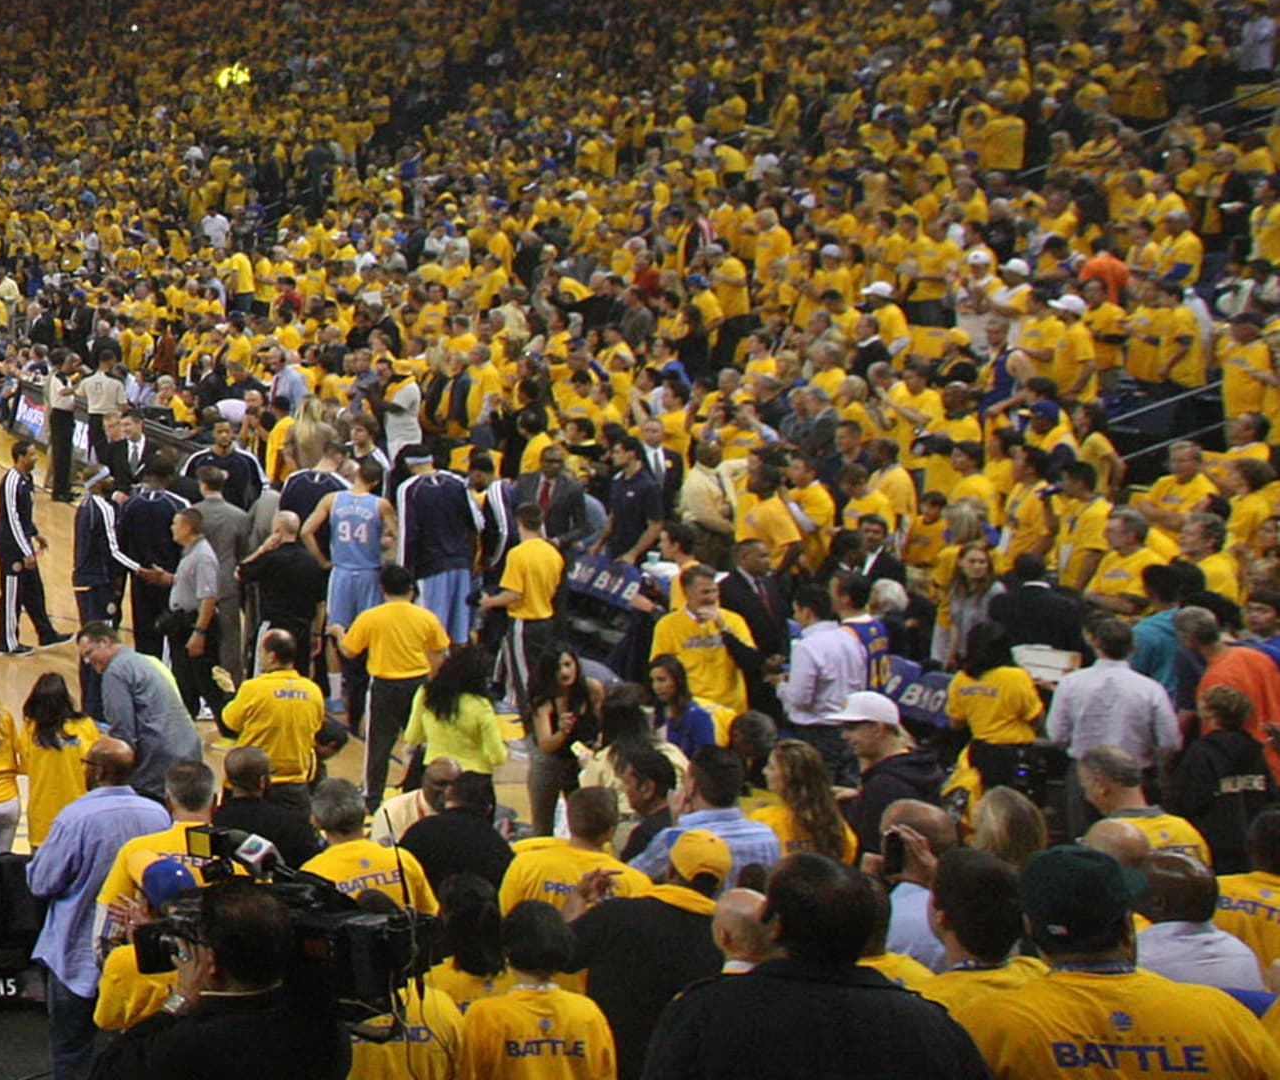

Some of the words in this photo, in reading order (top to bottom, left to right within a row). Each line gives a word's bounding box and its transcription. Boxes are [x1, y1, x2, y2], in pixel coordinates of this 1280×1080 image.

[337, 520, 370, 543] 94
[336, 871, 402, 893] BATTLE
[506, 1038, 585, 1058] BATTLE
[1052, 1042, 1209, 1073] BATTLE
